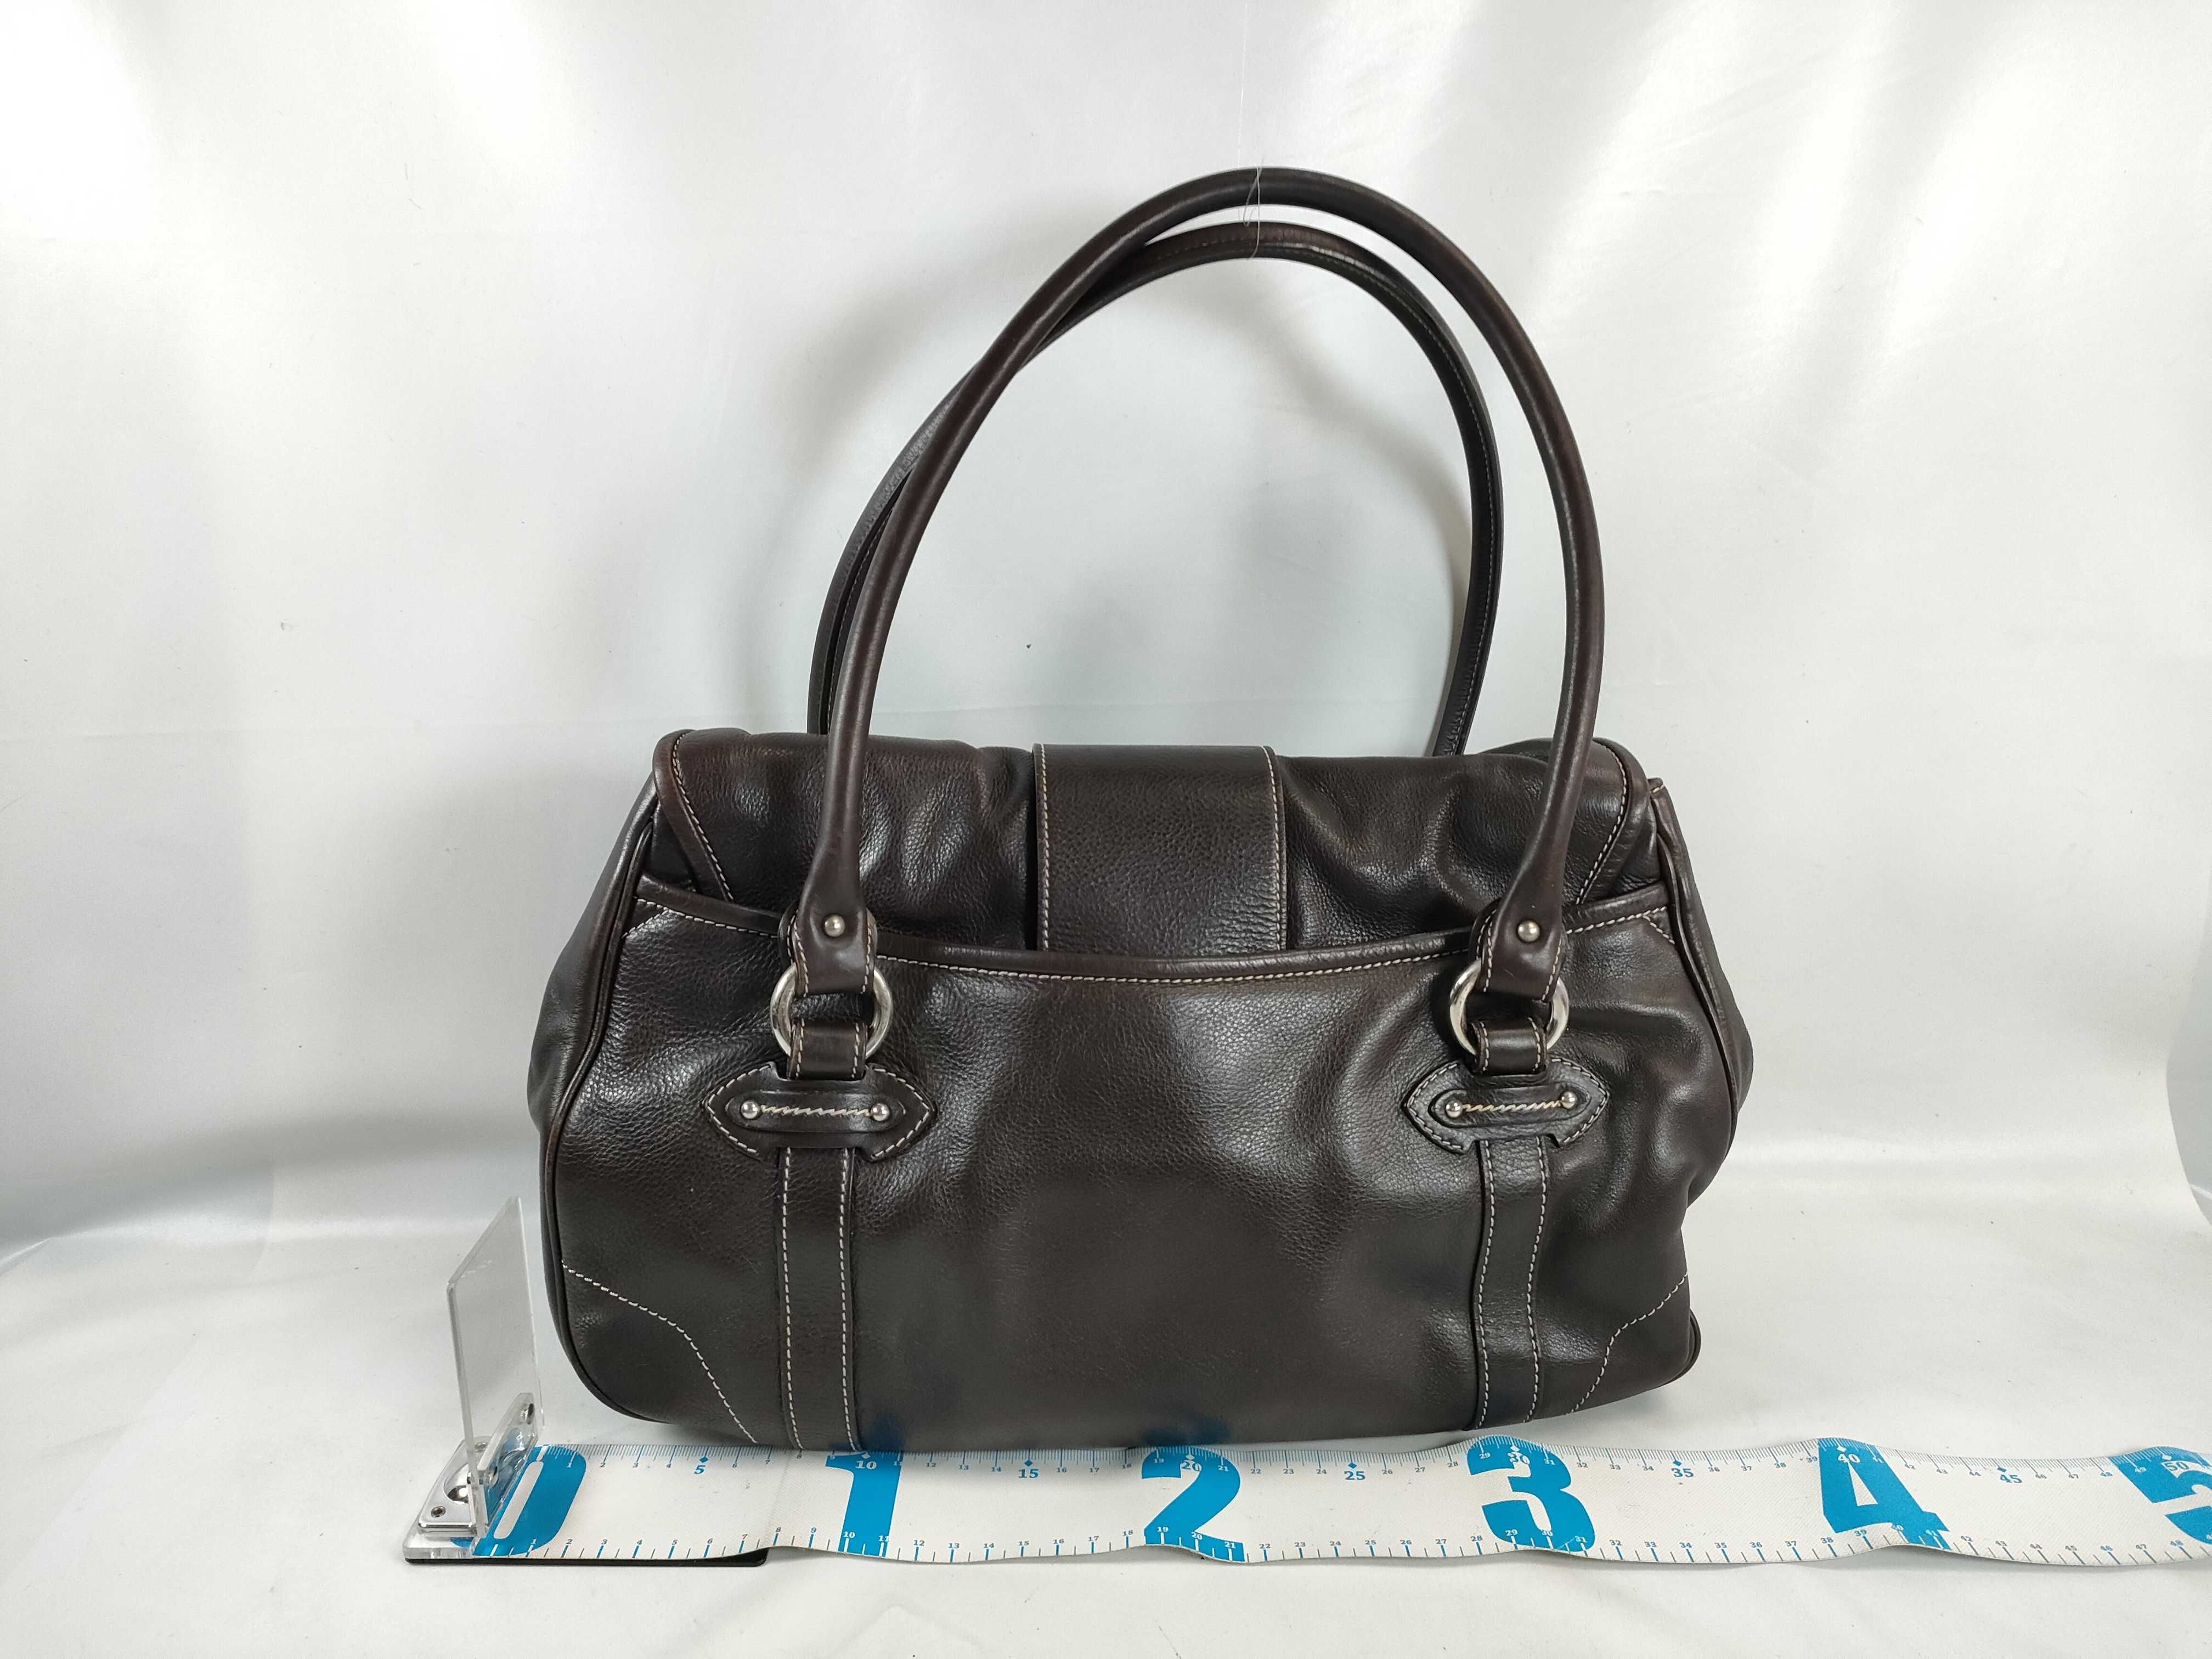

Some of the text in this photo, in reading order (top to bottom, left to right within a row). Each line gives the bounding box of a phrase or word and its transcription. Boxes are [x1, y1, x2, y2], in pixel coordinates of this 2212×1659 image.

[694, 1465, 706, 1475] 5
[855, 1461, 877, 1470] 10
[1018, 1469, 1039, 1478] 15
[1182, 1462, 1202, 1471] 20
[1345, 1471, 1365, 1480] 25
[1508, 1453, 1530, 1464] 30
[1671, 1468, 1694, 1477] 35
[1838, 1454, 1860, 1464] 40
[2000, 1475, 2022, 1483] 45
[2165, 1461, 2189, 1471] 50
[825, 1452, 904, 1558] 1
[1142, 1445, 1245, 1562] 2
[1467, 1435, 1595, 1553] 3
[1818, 1437, 1951, 1550] 4
